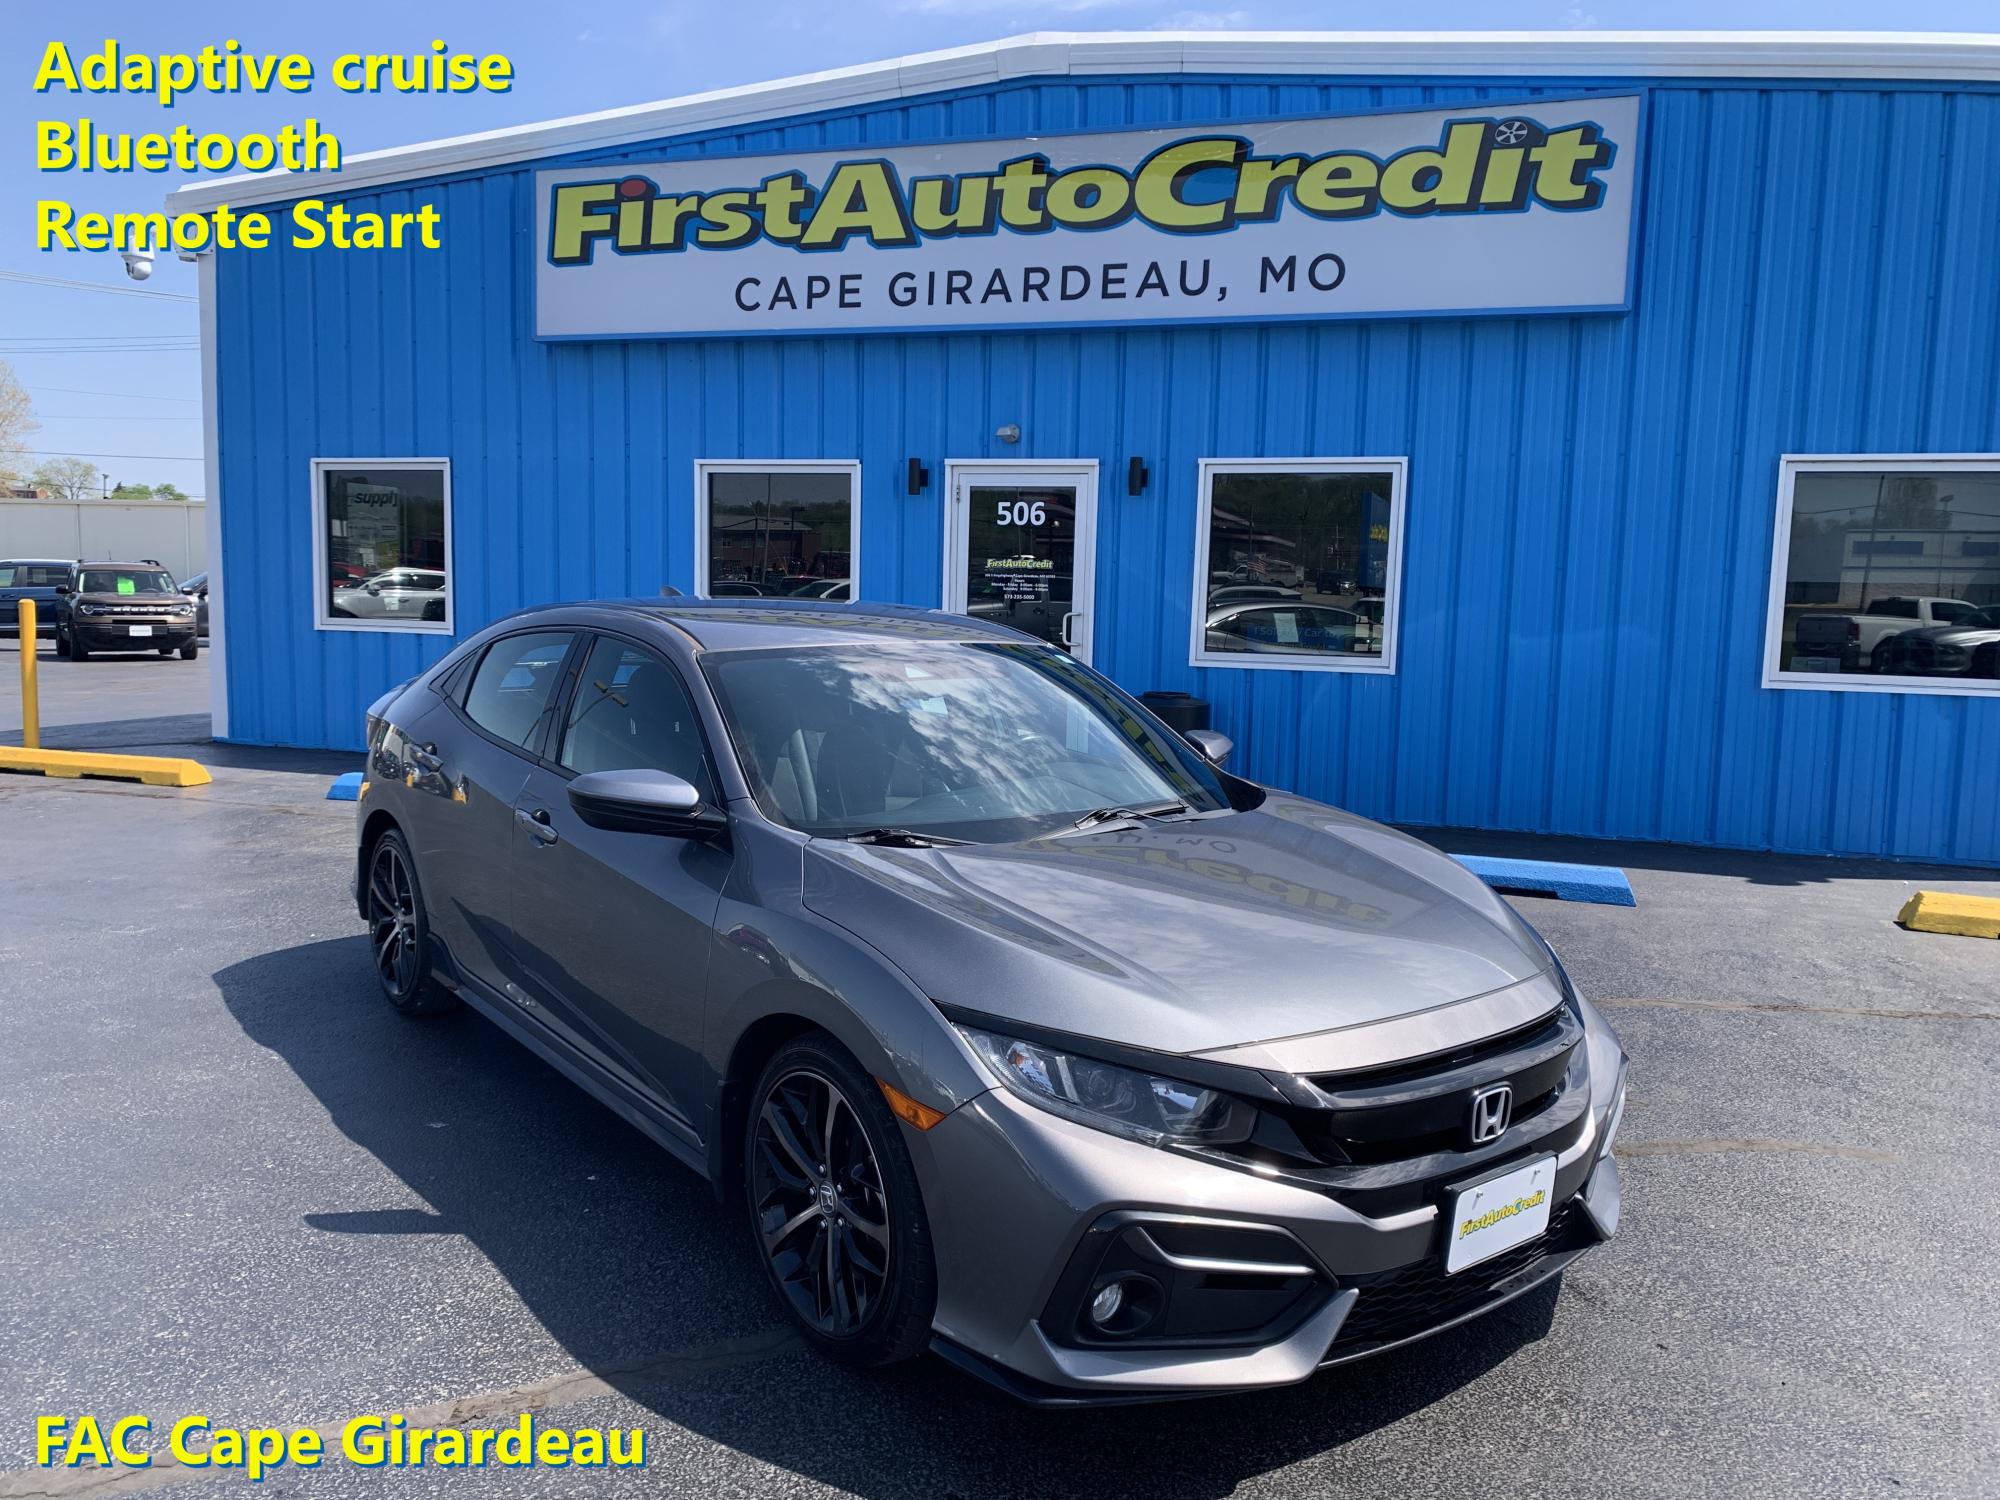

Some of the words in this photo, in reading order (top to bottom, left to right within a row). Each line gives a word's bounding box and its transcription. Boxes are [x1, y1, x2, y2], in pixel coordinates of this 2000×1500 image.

[548, 116, 1618, 267] FirstAutoCredit
[734, 273, 862, 312] CAPE
[887, 258, 1229, 307] GIRARDEAU,
[1260, 252, 1347, 293] MO
[996, 501, 1046, 526] 506
[985, 558, 1053, 569] FirstAutoCredit
[1458, 1189, 1546, 1240] FirstAutoCredit
